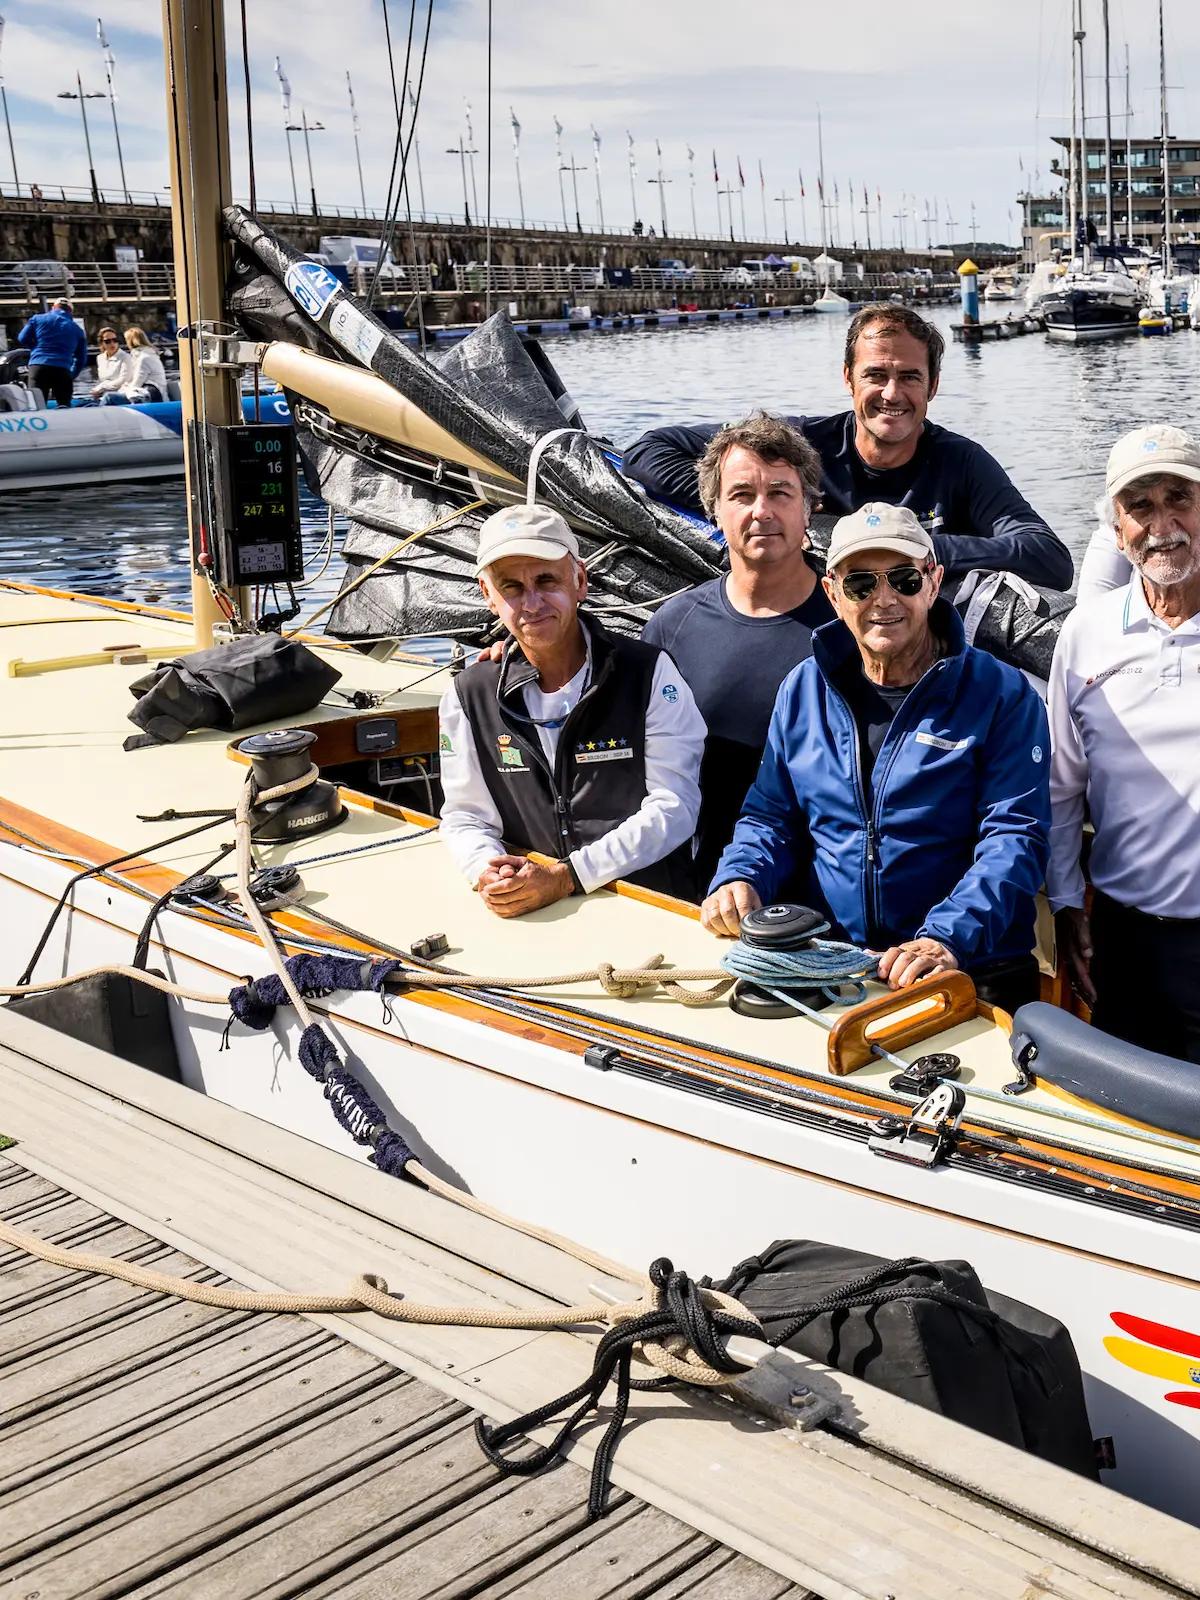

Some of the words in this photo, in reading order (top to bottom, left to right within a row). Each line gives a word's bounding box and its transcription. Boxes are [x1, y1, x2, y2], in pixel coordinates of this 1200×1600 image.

[254, 440, 282, 453] 0.00
[267, 461, 283, 474] 16
[261, 483, 283, 496] 231
[243, 505, 262, 516] 247
[271, 504, 285, 514] 2.4
[287, 811, 329, 829] HARKEN
